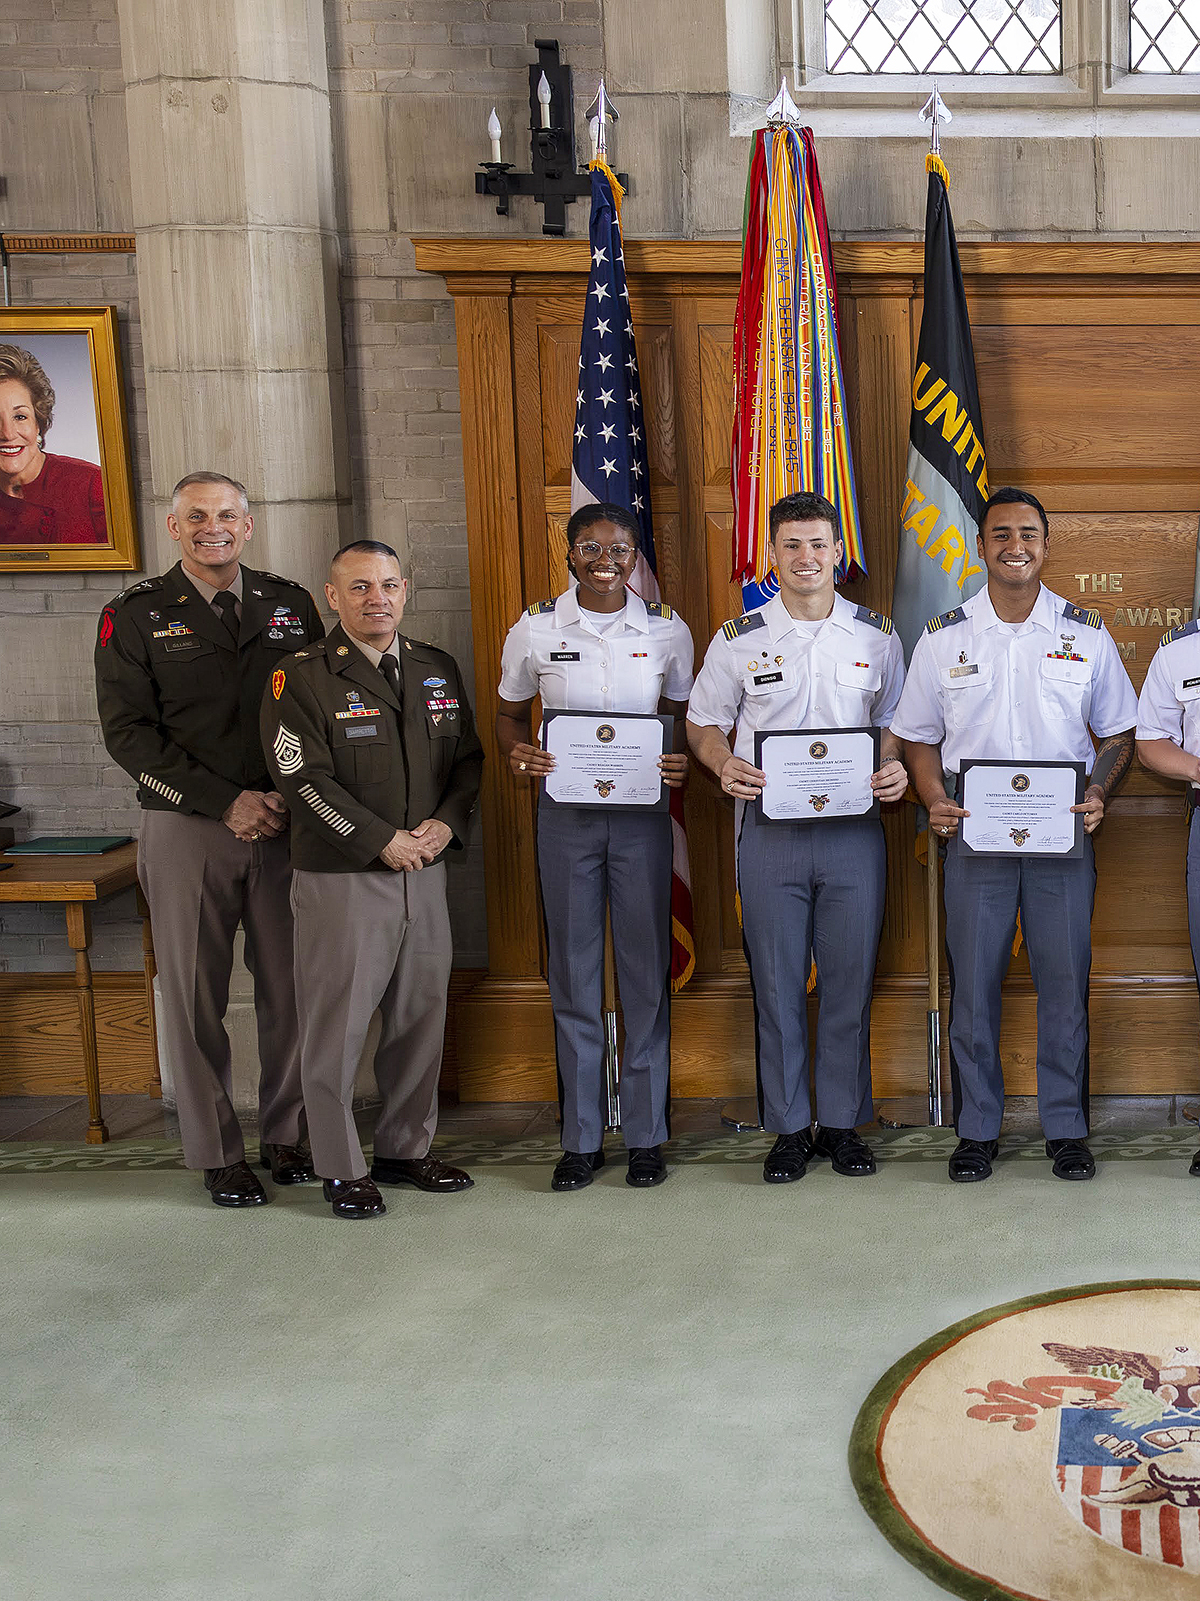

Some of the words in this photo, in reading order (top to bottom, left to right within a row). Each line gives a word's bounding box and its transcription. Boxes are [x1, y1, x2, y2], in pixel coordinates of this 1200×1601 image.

[774, 237, 790, 284] CHINA
[778, 297, 795, 380] DEFENSIVE
[802, 416, 812, 441] 1918
[900, 478, 984, 590] TARY
[1075, 573, 1123, 593] THE
